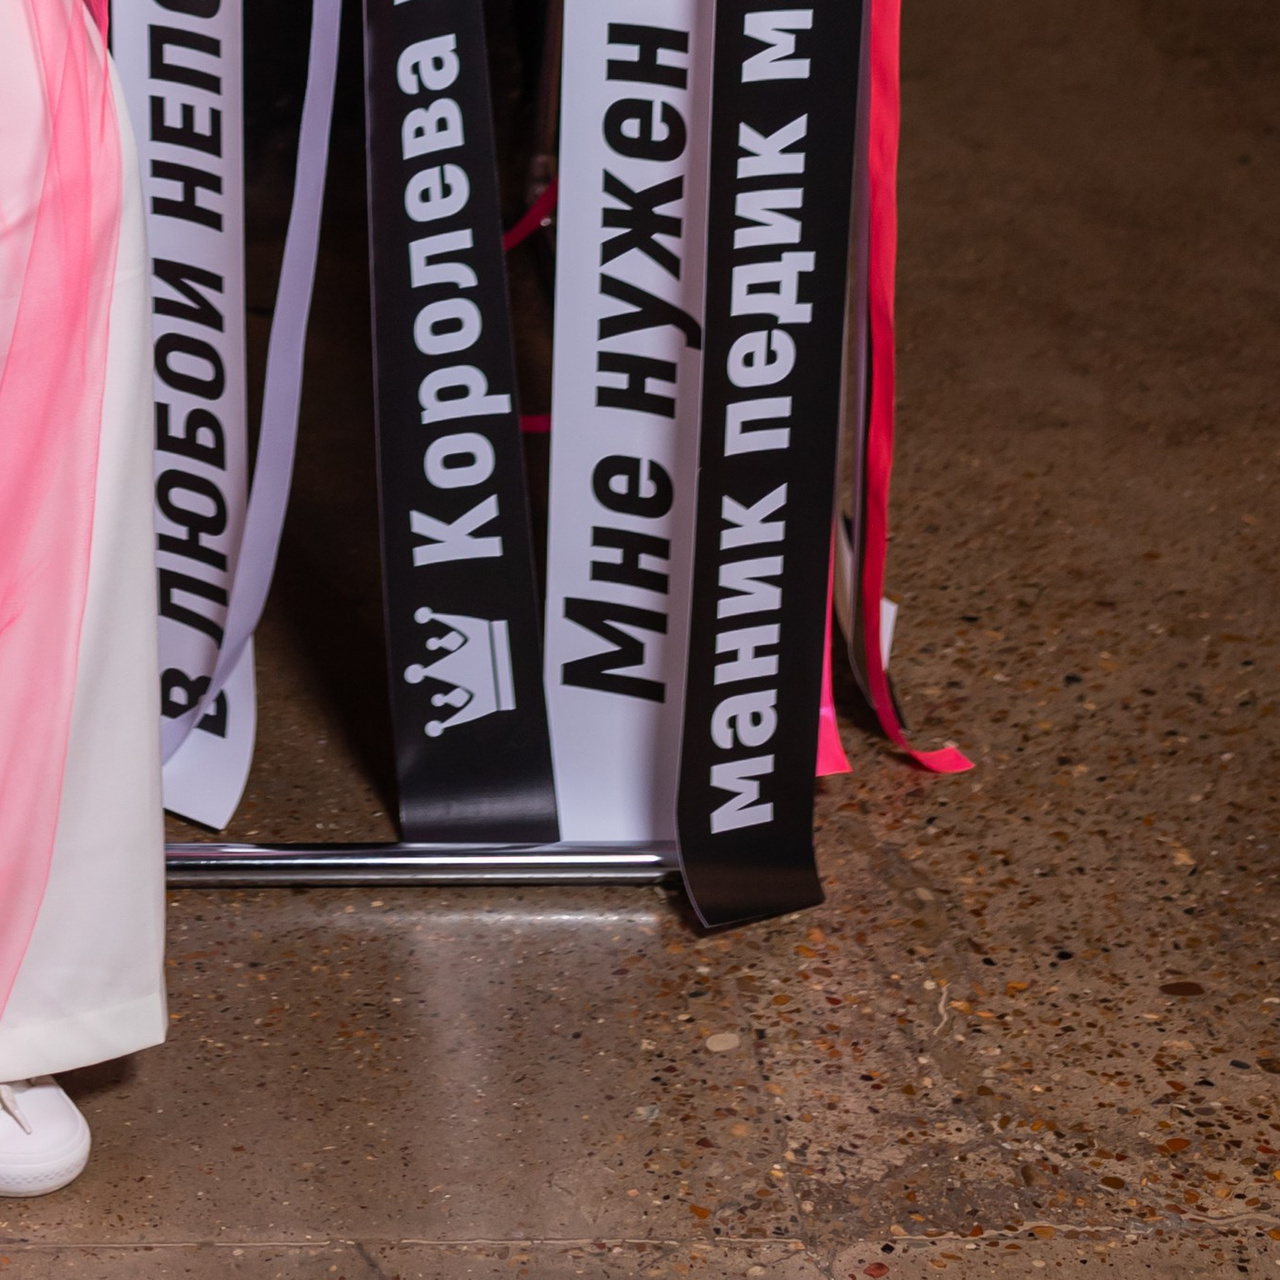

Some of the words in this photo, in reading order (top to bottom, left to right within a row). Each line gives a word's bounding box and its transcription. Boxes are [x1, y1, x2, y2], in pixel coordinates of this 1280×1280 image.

[395, 33, 512, 567] Королева
[596, 22, 702, 419] нужен
[724, 113, 816, 457] педик
[161, 666, 229, 740] В
[560, 454, 675, 703] Мне
[710, 482, 788, 833] маник
